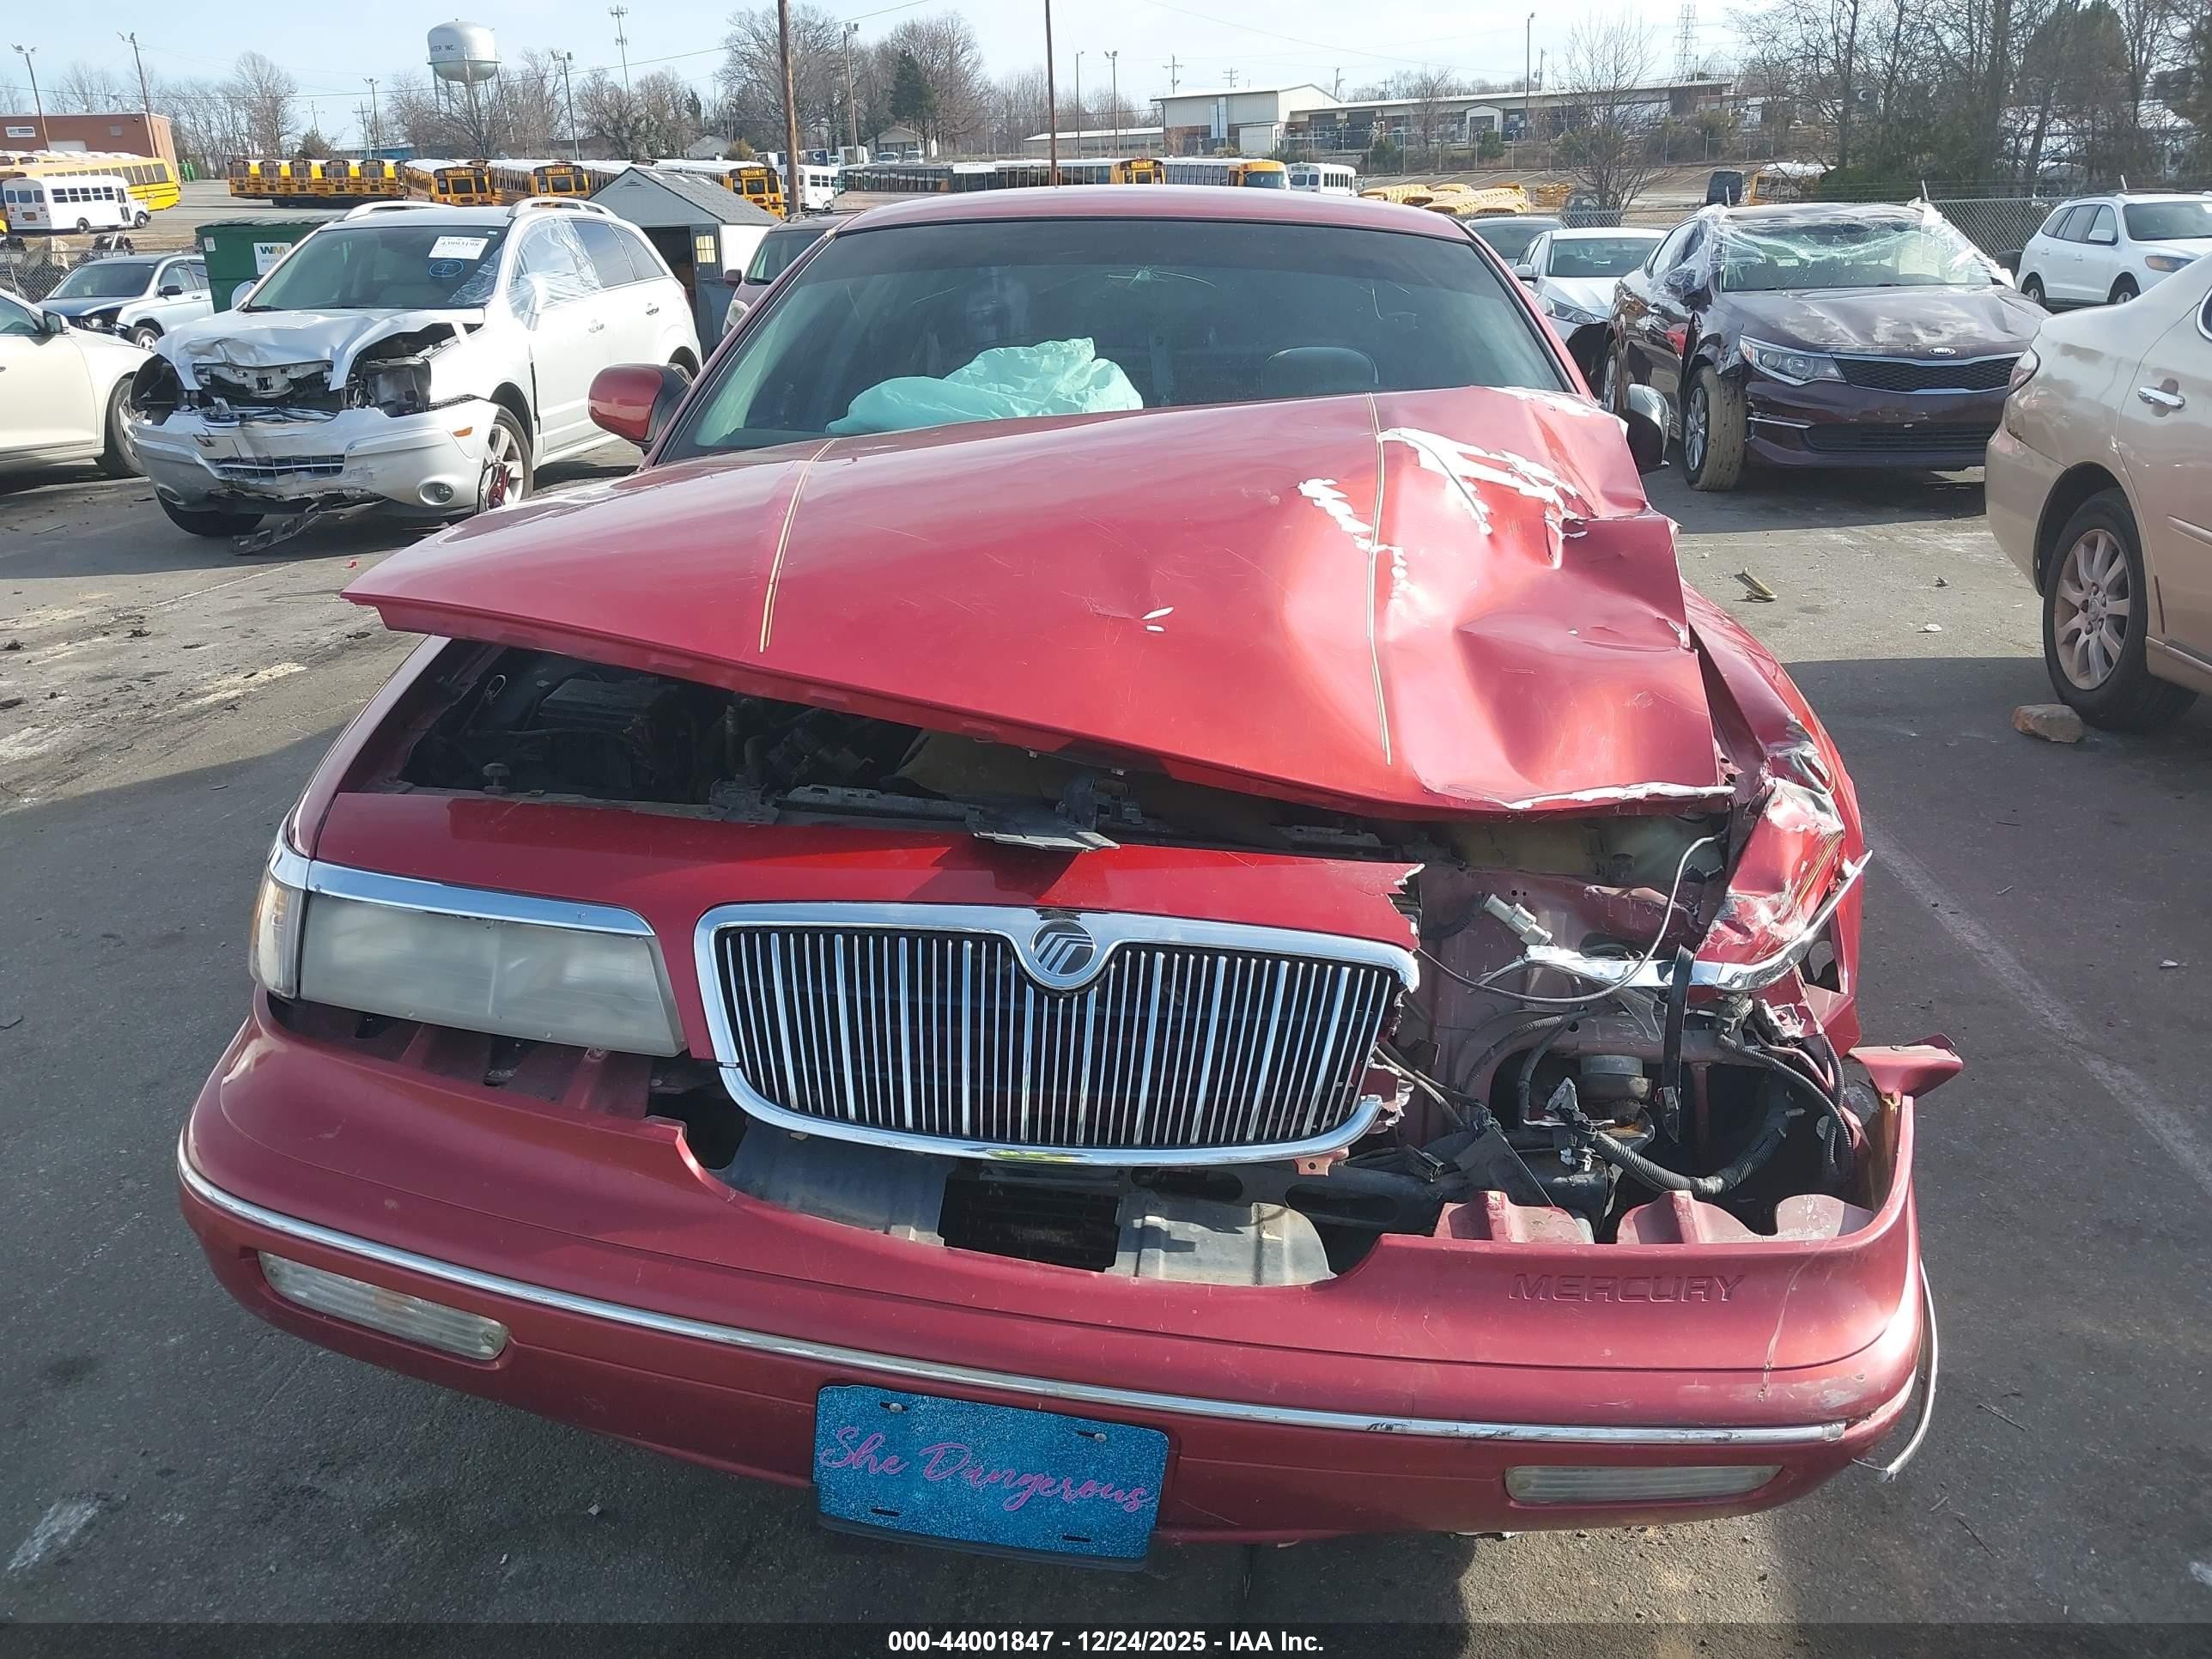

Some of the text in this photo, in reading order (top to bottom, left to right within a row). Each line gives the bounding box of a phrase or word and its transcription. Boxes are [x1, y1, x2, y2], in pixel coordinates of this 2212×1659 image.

[259, 246, 287, 255] WM
[1509, 1273, 1746, 1304] MERCURY
[819, 1425, 1154, 1513] She Dangerous
